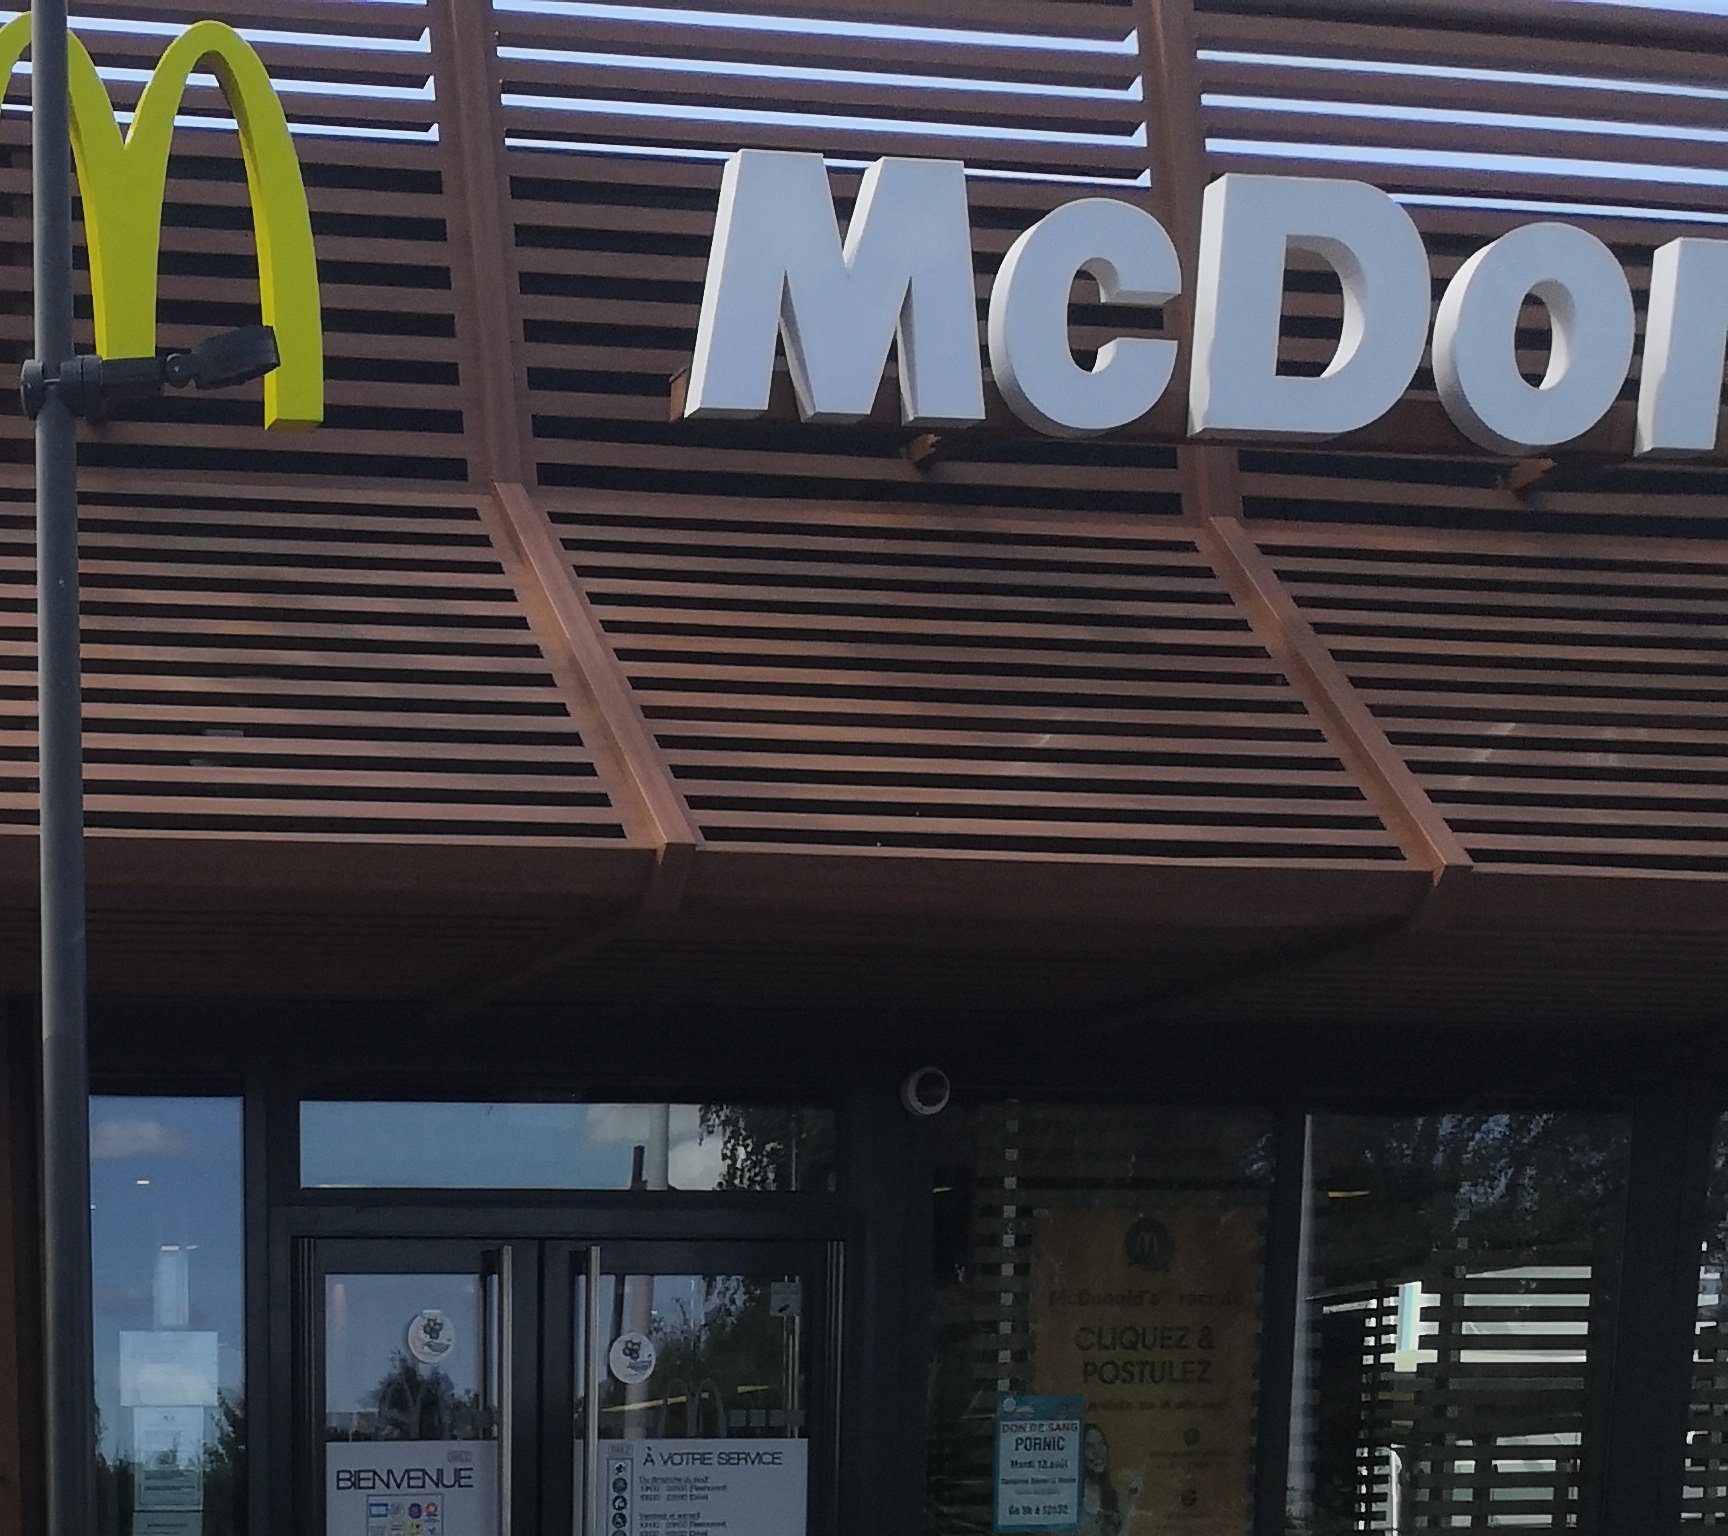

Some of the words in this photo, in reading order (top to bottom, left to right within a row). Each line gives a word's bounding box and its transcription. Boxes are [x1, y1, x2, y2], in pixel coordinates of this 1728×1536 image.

[1075, 1326, 1190, 1351] CLIQUEZ
[1197, 1326, 1215, 1350] &
[1082, 1359, 1212, 1385] POSTULEZ
[643, 1446, 655, 1466] À
[660, 1451, 712, 1466] VOTRE
[717, 1451, 783, 1466] SERVICE
[1014, 1436, 1066, 1452] PORNIC
[336, 1467, 474, 1491] BIENVENUE
